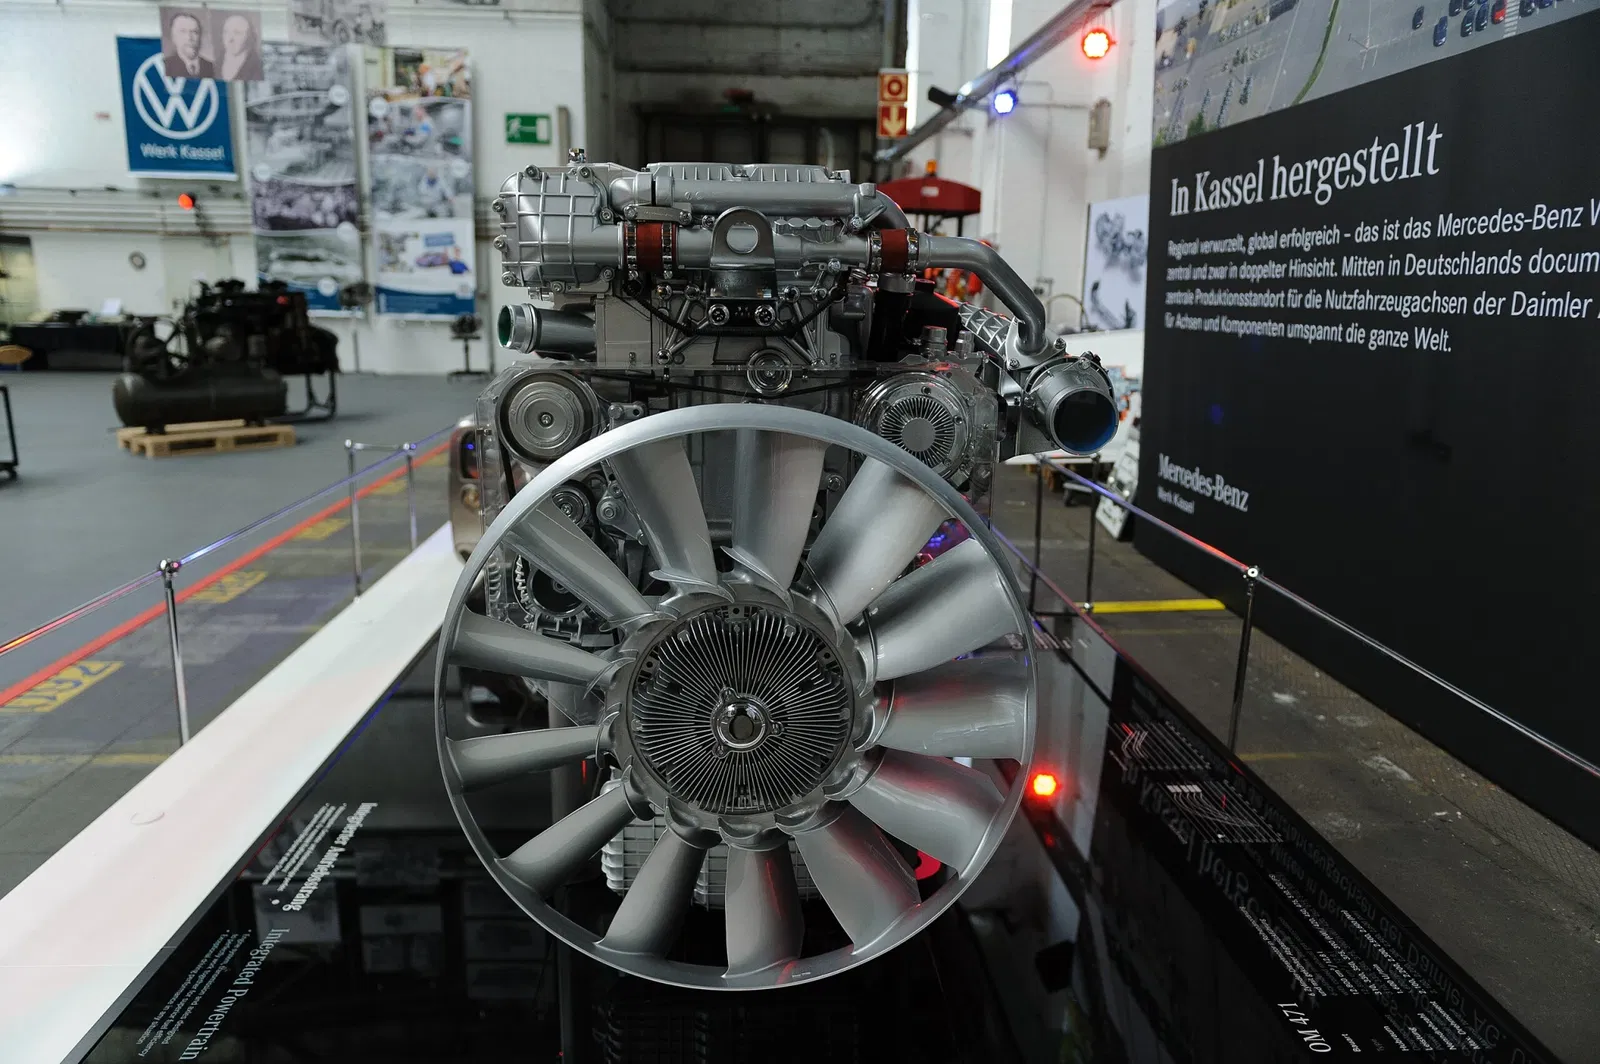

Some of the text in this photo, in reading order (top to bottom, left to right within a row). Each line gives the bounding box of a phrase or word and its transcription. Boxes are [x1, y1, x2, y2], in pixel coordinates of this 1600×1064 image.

[140, 143, 225, 160] Werk Kassel
[1170, 120, 1443, 216] In Kassel hergestellt
[1167, 237, 1200, 260] Regional
[1200, 233, 1246, 254] verwurzelt,
[1247, 229, 1278, 256] global
[1279, 224, 1340, 252] erfolgreich
[1355, 221, 1379, 243] das
[1383, 219, 1400, 241] ist
[1403, 216, 1431, 239] das
[1437, 203, 1584, 237] Mercedes-Benz
[1166, 263, 1192, 281] zentral
[1192, 263, 1208, 280] und
[1208, 267, 1228, 280] zwar
[1228, 262, 1238, 279] in
[1239, 260, 1287, 283] doppelter
[1288, 257, 1338, 278] Hinsicht.
[1342, 254, 1385, 277] Mitten
[1388, 254, 1401, 276] in
[1404, 249, 1522, 277] Deutschlands
[1194, 288, 1285, 308] Produktionsstandort
[1287, 288, 1302, 309] für
[1304, 289, 1323, 309] die
[1324, 288, 1468, 318] Nutzfahrzeugachsen
[1473, 291, 1506, 316] der
[1510, 291, 1593, 319] Daimler
[1175, 313, 1203, 331] Achsen
[1203, 315, 1220, 332] und
[1221, 315, 1284, 338] Komponenten
[1287, 322, 1343, 344] umspannt
[1346, 322, 1366, 344] die
[1368, 329, 1409, 351] ganze
[1414, 326, 1452, 353] Welt.
[1158, 452, 1249, 512] Mercedes-Benz
[178, 928, 290, 1061] Integrated Powertrain
[1277, 1003, 1310, 1026] 471
[1297, 1029, 1331, 1053] OM
